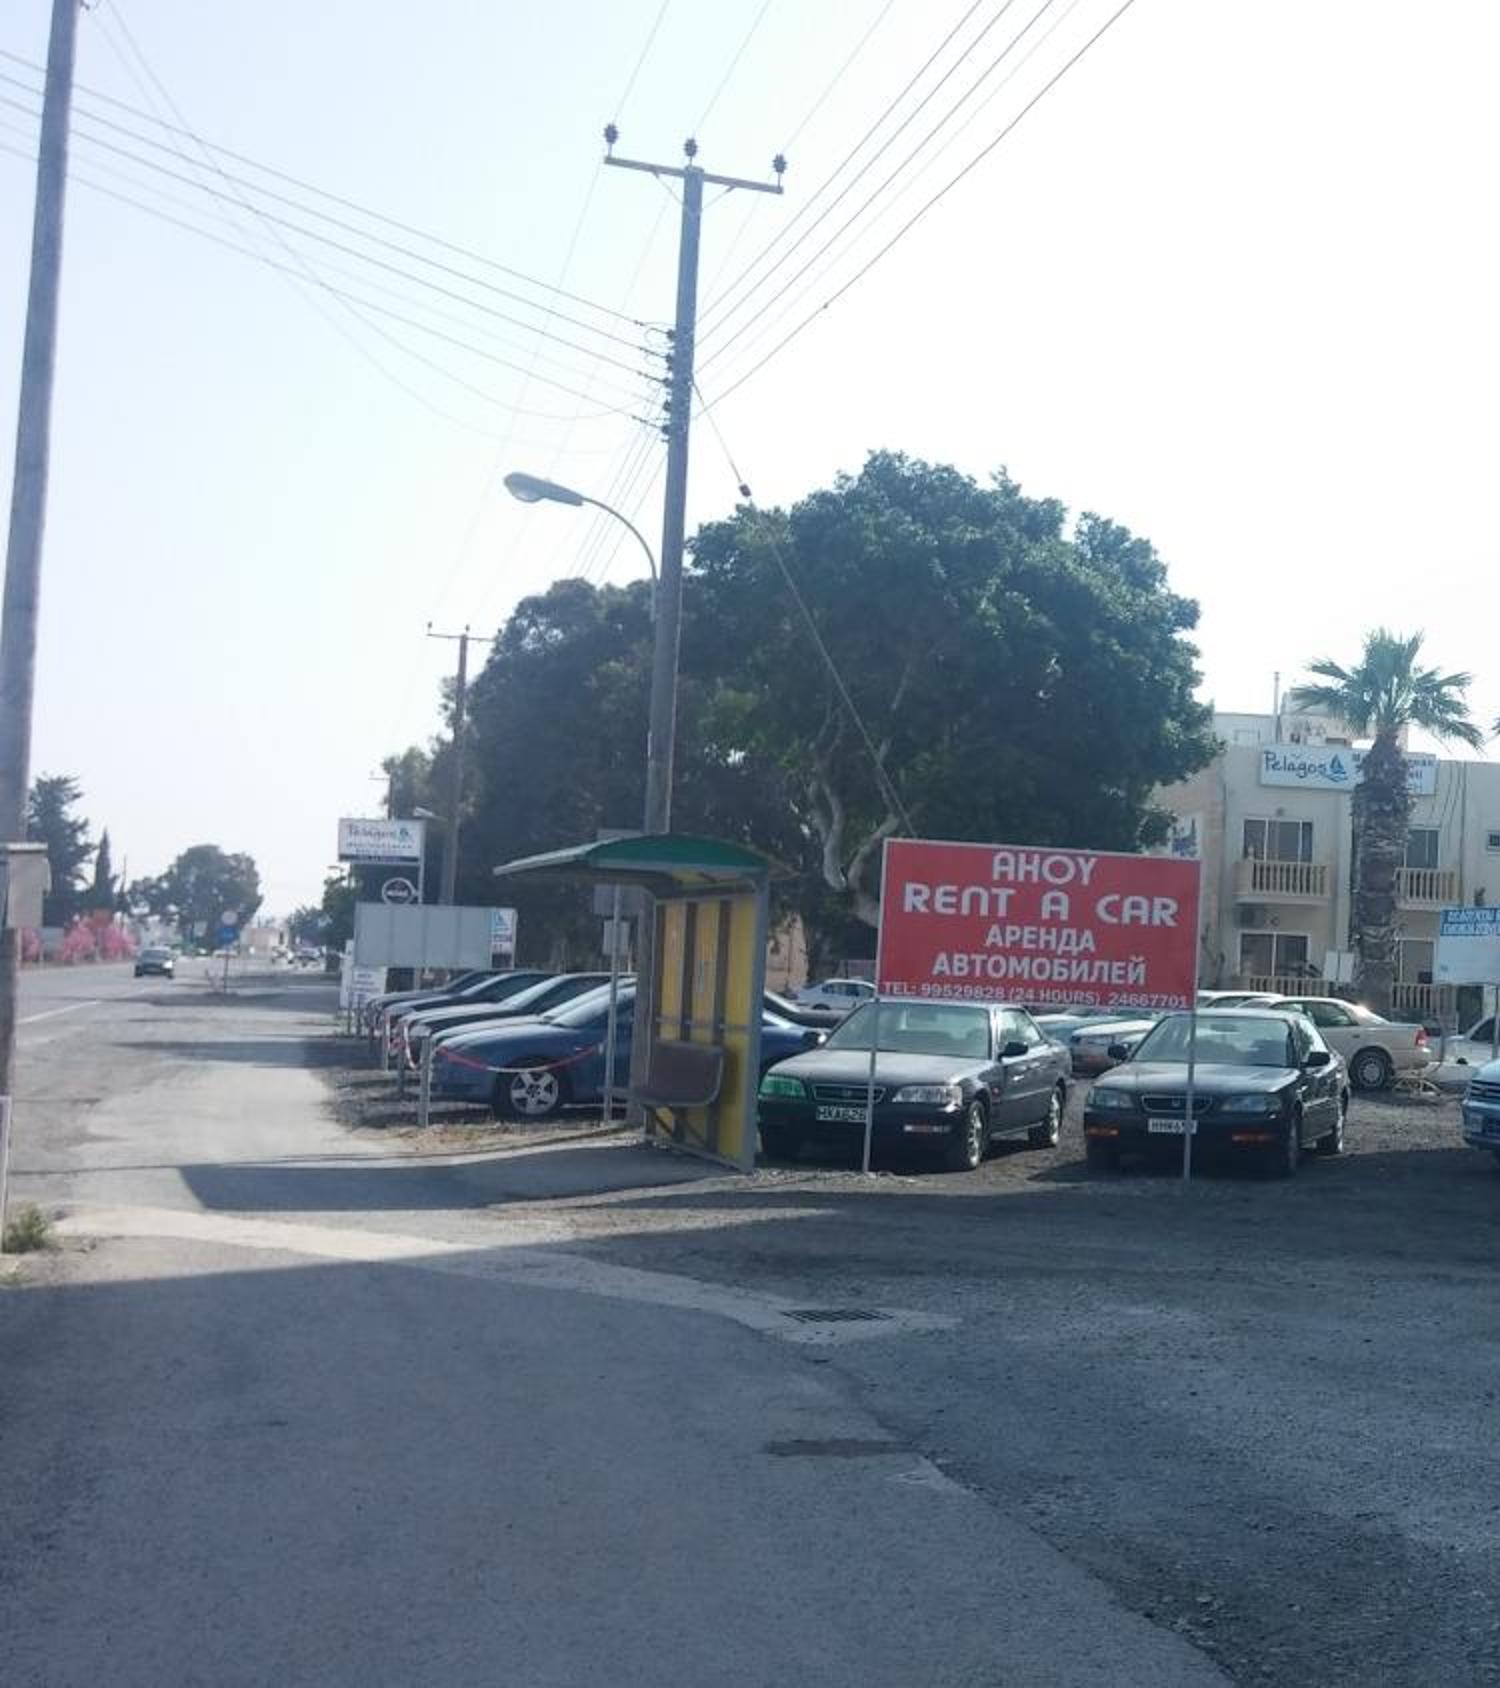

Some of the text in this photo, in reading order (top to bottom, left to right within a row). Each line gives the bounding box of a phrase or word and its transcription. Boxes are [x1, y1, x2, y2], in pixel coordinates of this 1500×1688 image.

[1264, 751, 1327, 778] Pelagos
[992, 851, 1098, 885] AHOY
[904, 883, 1178, 926] RENT A CAR
[985, 925, 1096, 955] АРЕНДА
[932, 953, 1145, 985] АВТОМОБИЛЕЙ
[884, 980, 917, 994] TEL:
